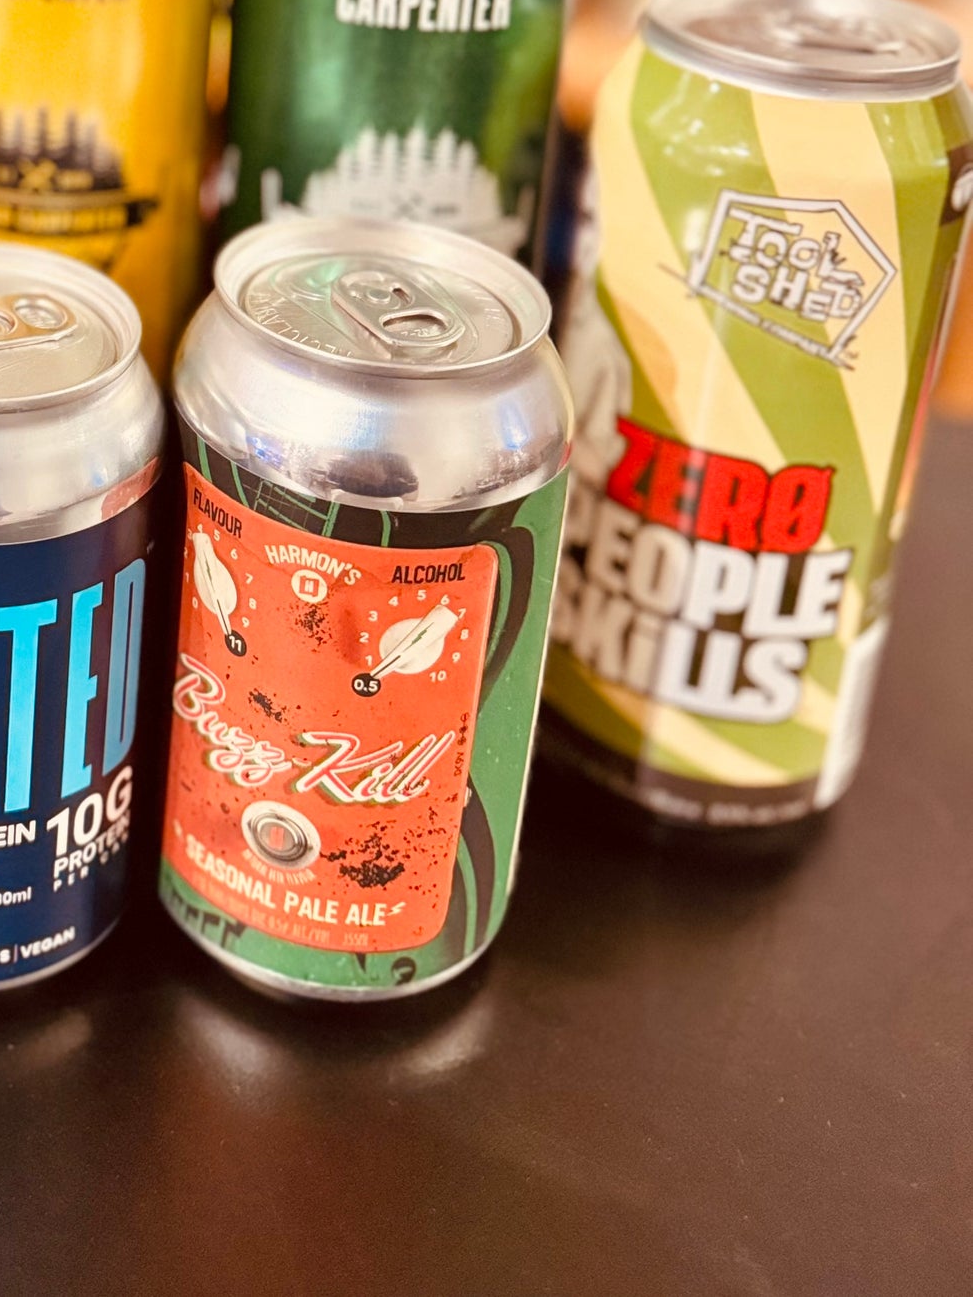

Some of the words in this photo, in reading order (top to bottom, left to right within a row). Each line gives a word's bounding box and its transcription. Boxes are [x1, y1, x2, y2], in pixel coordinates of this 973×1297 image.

[732, 264, 863, 322] SHED
[193, 487, 243, 539] FLAVOUR
[213, 529, 221, 542] 5
[230, 548, 239, 561] 6
[264, 544, 363, 587] HARMON'S
[245, 572, 254, 585] 7
[391, 562, 467, 585] ALCOHOL
[388, 595, 399, 607] 4
[416, 589, 427, 601] 5
[440, 593, 450, 606] 6
[249, 597, 257, 610] 8
[368, 610, 378, 623] 3
[456, 608, 467, 620] 7
[241, 616, 250, 629] 9
[359, 631, 369, 644] 2
[460, 628, 470, 641] 8
[229, 634, 243, 653] 11
[365, 654, 373, 667] 1
[452, 651, 461, 664] 9
[429, 670, 447, 683] 10
[353, 678, 379, 692] 0.5
[173, 653, 293, 787] Buzz
[295, 730, 456, 803] Kill
[46, 765, 133, 857] 10G
[186, 833, 277, 909] SEASONAL
[283, 891, 339, 924] PALE
[345, 902, 387, 927] ALE
[20, 926, 76, 960] VEGAN
